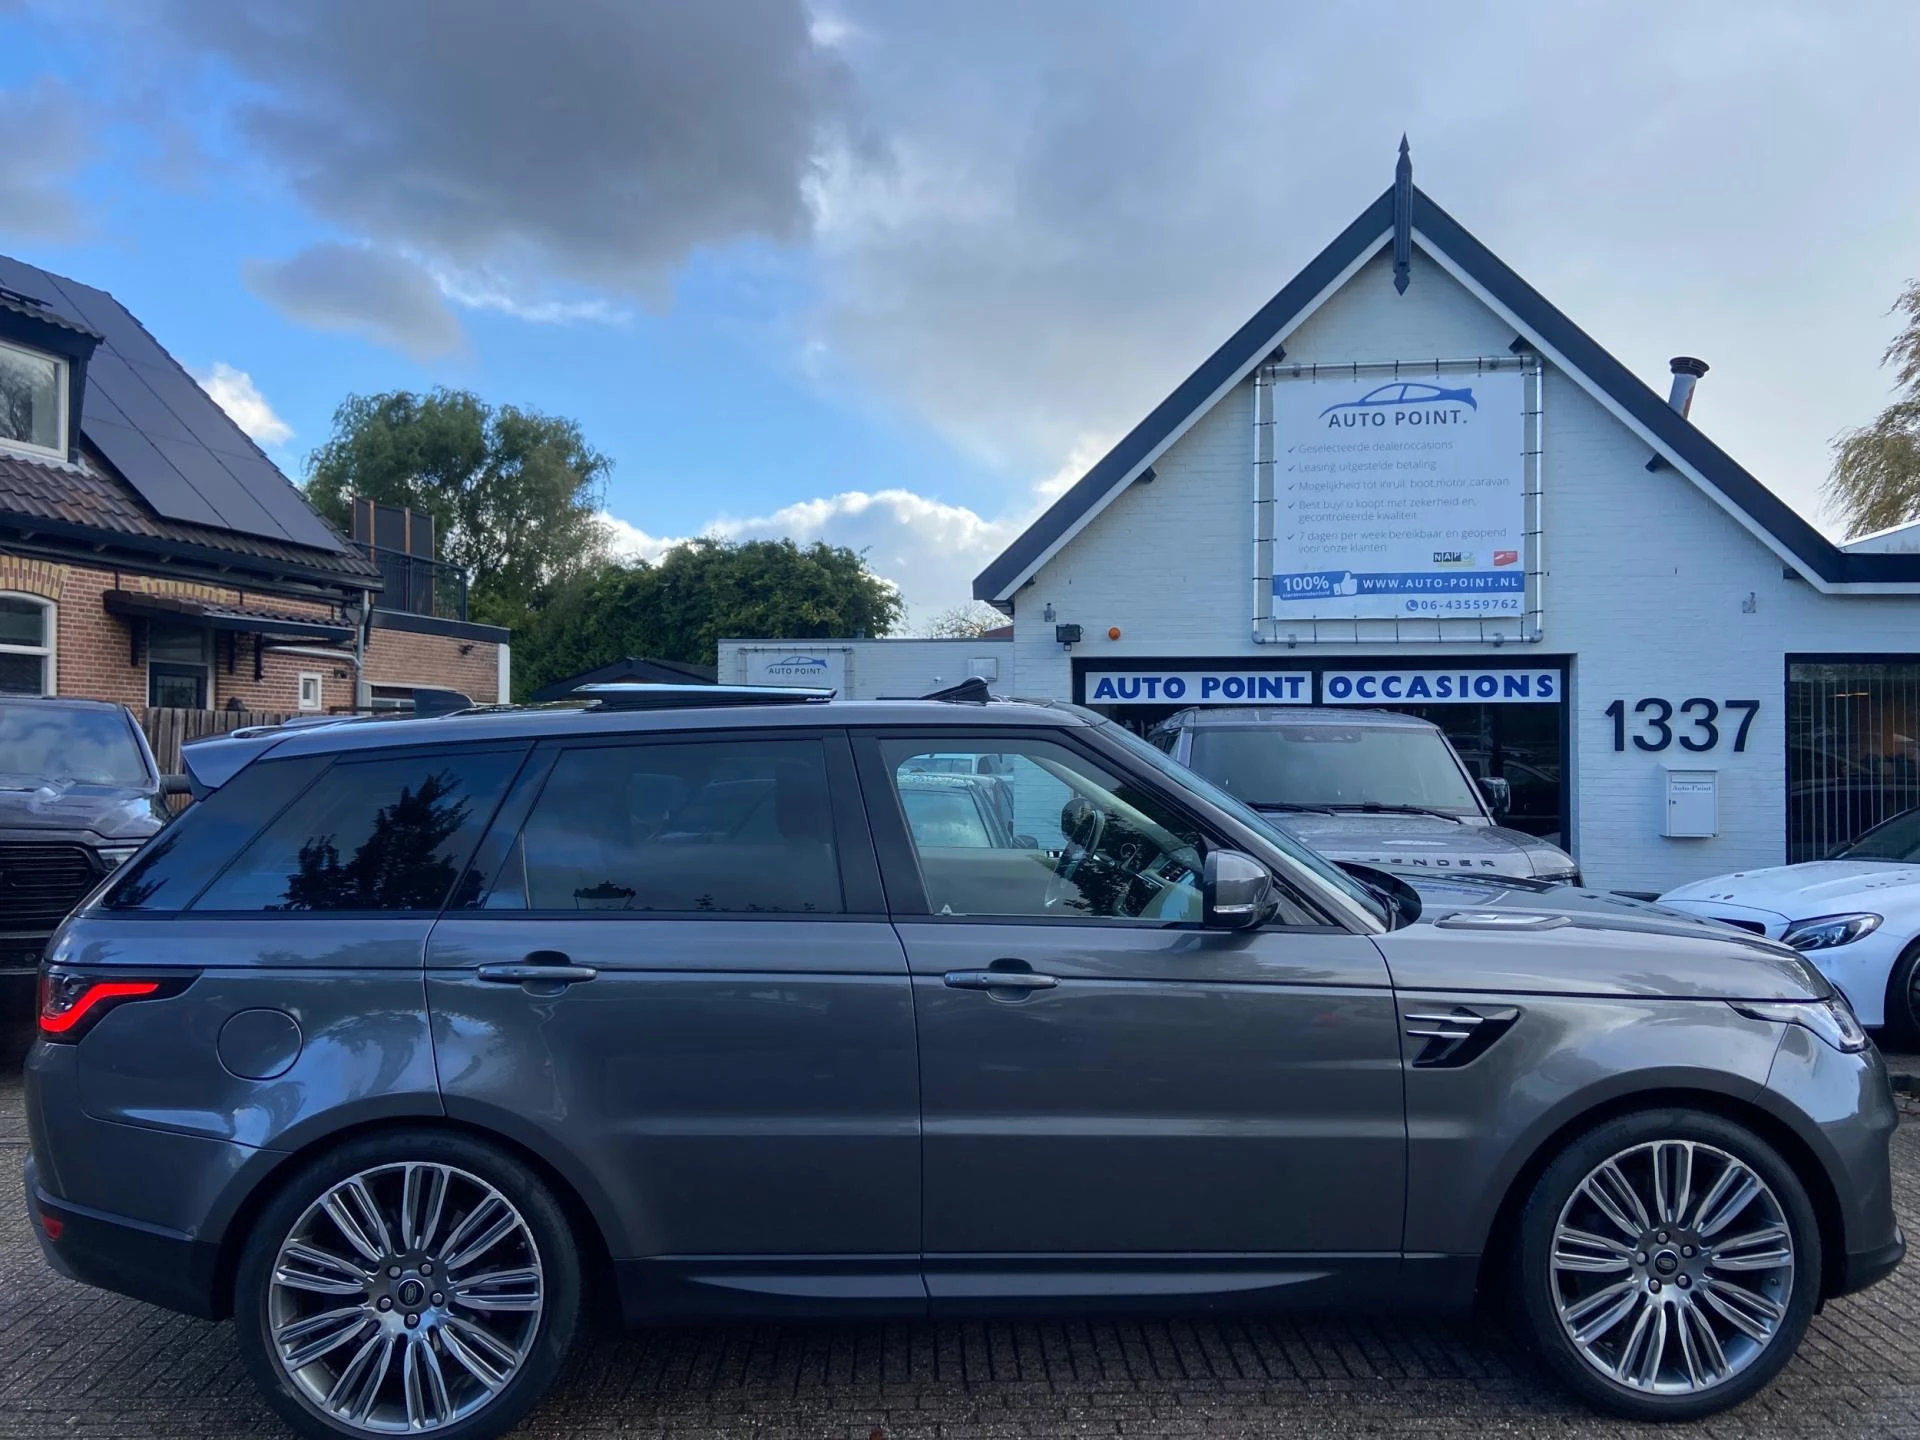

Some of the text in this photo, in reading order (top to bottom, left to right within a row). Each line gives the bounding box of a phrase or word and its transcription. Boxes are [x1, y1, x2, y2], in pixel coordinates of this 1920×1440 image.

[1328, 410, 1468, 428] AUTO POINT.
[1299, 440, 1453, 454] Geselecteerde dealeroccasions
[1299, 460, 1437, 474] Leasing uitgestelde betaling
[1299, 480, 1360, 493] Mogelijkheid
[1363, 480, 1377, 490] tot
[1299, 500, 1320, 510] Best
[1356, 499, 1384, 510] koopt
[1387, 499, 1408, 508] met
[1409, 497, 1459, 508] zekerheid
[1298, 510, 1417, 525] gecontroleerde kwaliteit
[1299, 528, 1507, 542] 7 dagen per week bereikbaar en geopend
[1298, 541, 1387, 554] voor onze klanten
[1283, 576, 1519, 592] 100% WWW.AUTO-POINT.NL
[1421, 599, 1518, 610] 06-43559762
[1094, 676, 1305, 699] AUTO POINT
[1328, 674, 1554, 698] OCCASIONS
[1605, 697, 1760, 753] 1337
